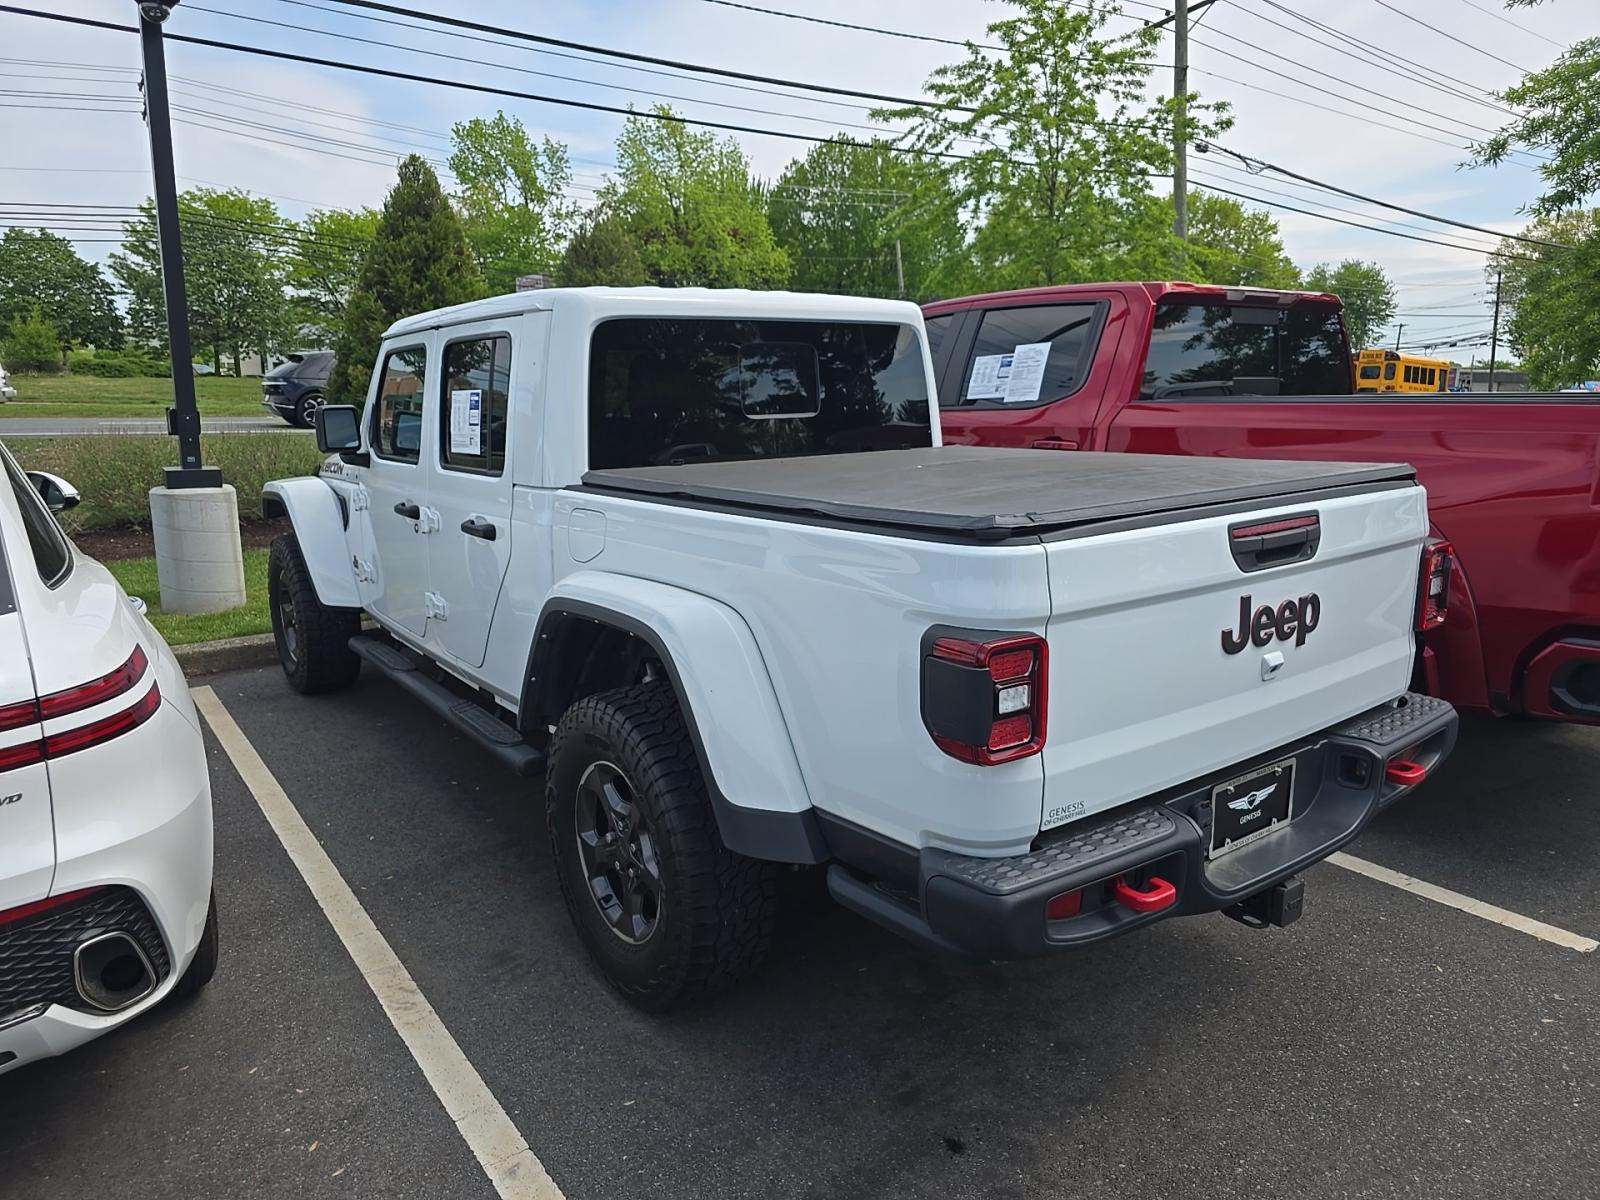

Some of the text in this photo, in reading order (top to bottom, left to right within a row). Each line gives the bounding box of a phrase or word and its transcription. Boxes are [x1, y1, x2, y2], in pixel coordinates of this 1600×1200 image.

[1221, 592, 1320, 655] Jeep
[1048, 801, 1085, 818] GENESIS
[1240, 810, 1261, 824] GENESIS
